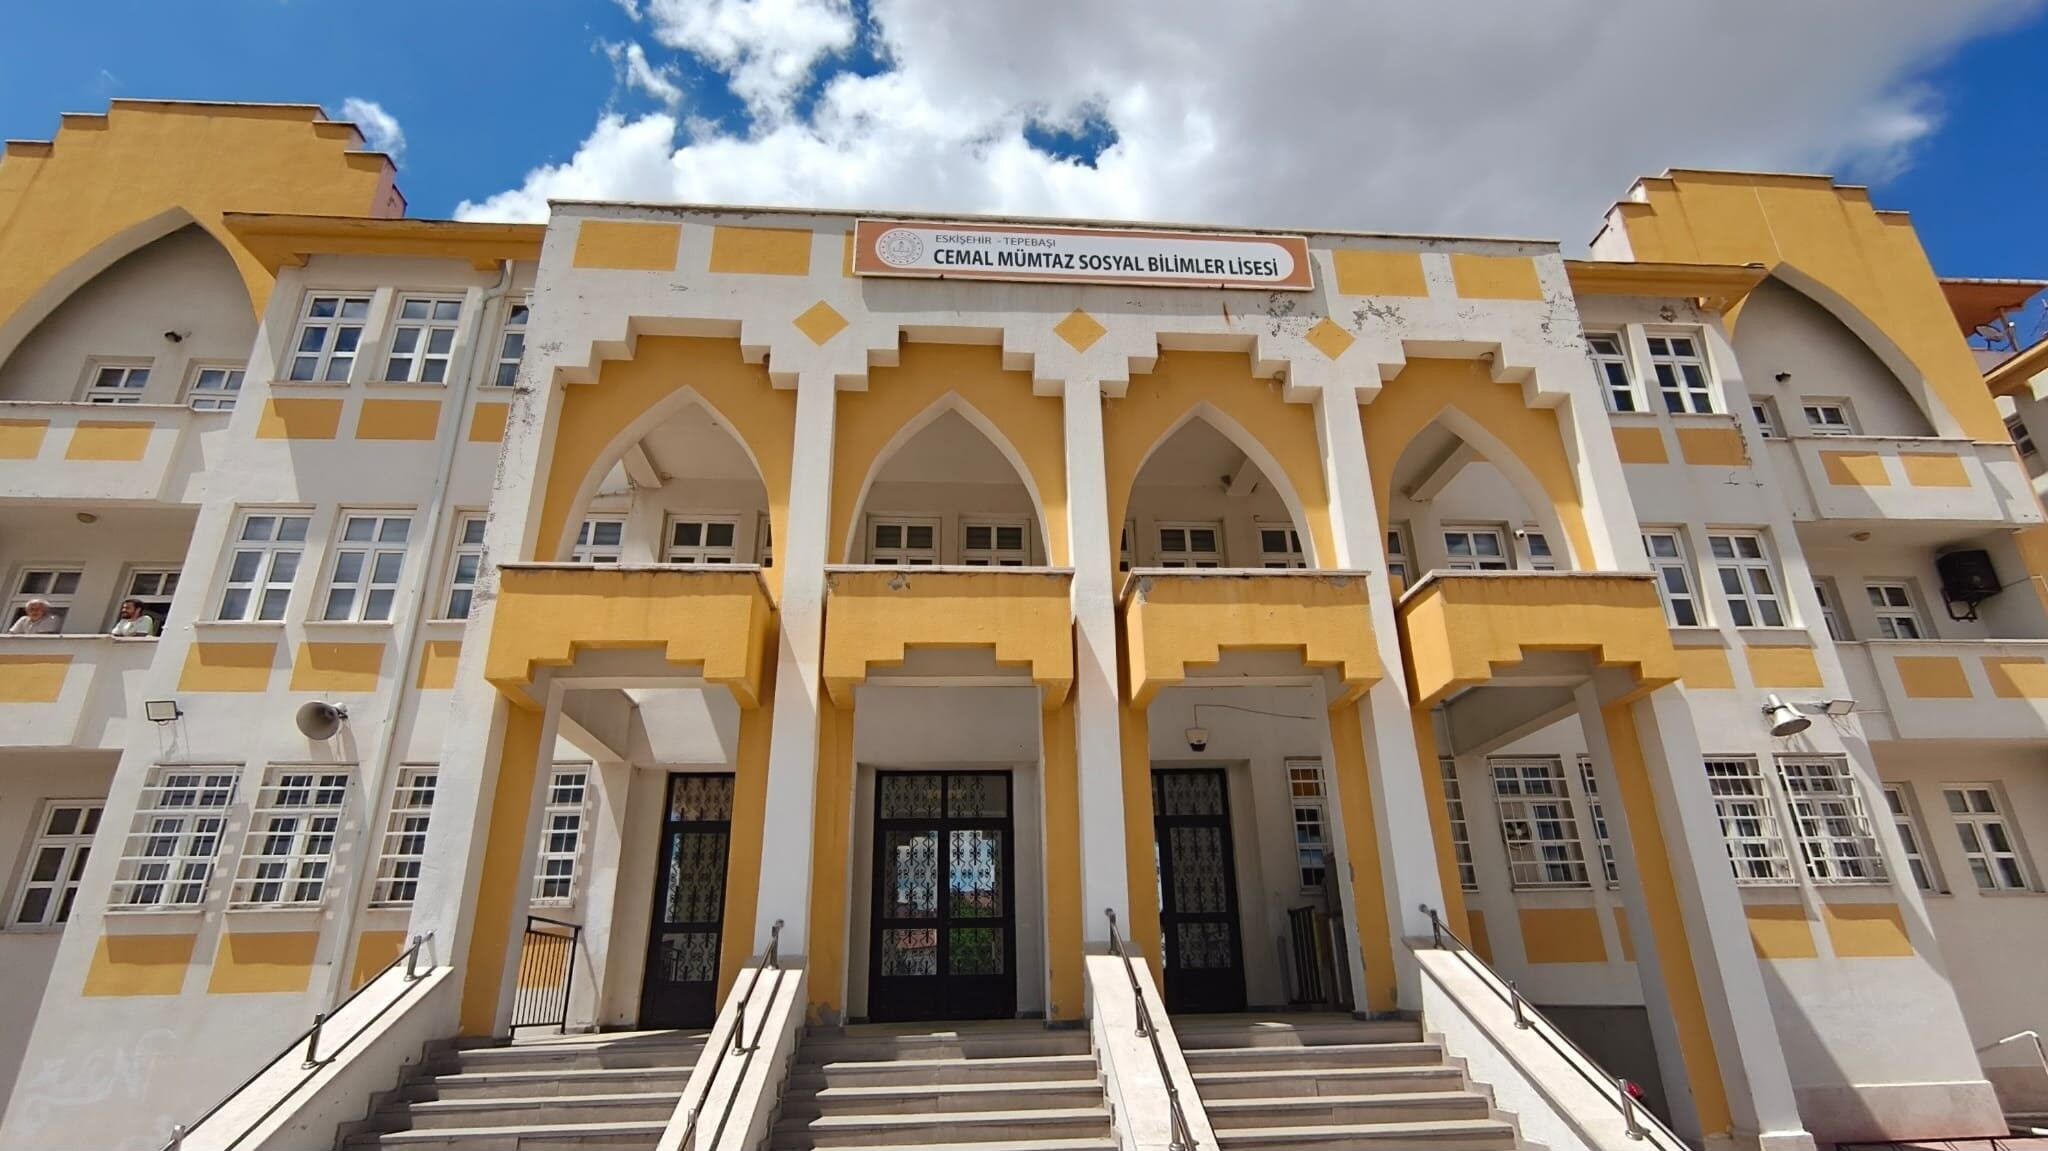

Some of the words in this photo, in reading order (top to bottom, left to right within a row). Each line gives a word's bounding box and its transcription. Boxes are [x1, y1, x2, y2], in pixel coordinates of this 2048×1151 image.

[935, 232, 992, 245] ESKİŞEHİR
[1003, 236, 1056, 249] TEPEBAŞI
[933, 248, 994, 267] CEMAL
[998, 248, 1075, 270] MÜMTAZ
[1078, 254, 1145, 272] SOSYAL
[1147, 253, 1226, 275] BİLİMLER
[1228, 256, 1279, 277] LİSESİ
